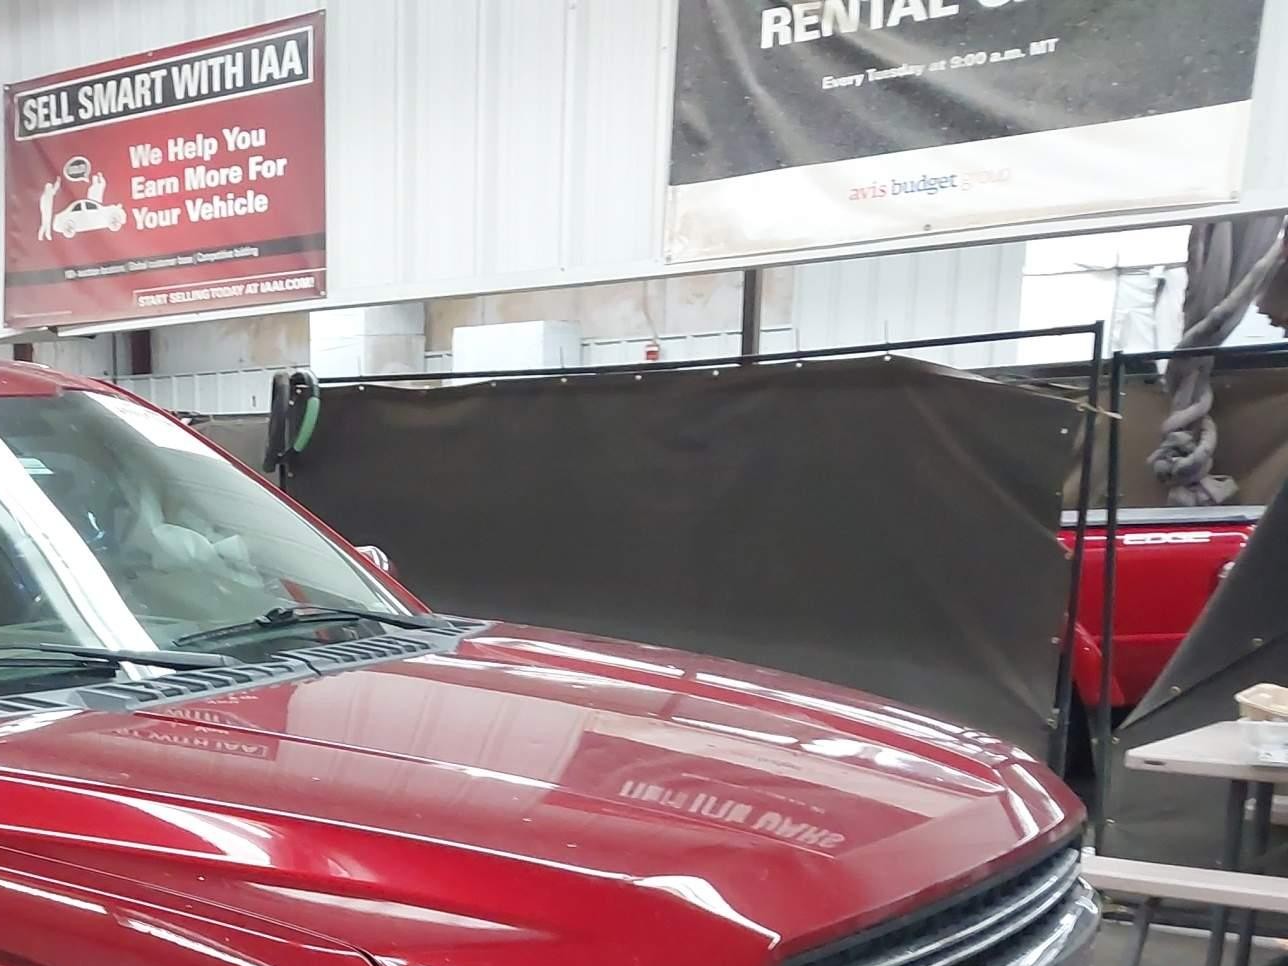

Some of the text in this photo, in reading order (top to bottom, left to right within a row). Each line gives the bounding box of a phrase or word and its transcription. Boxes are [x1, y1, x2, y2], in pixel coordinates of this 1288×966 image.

[760, 0, 961, 49] RENTAL
[821, 38, 1060, 89] Every Tuesday at 9:00 a.m. MT
[22, 40, 304, 131] SELL SMART WITH IAA
[128, 126, 266, 169] We Help You
[130, 156, 288, 200] Earn More For
[848, 181, 888, 200] avis
[891, 174, 959, 195] budget
[132, 189, 269, 230] Your Vehicle
[138, 292, 169, 307] START
[169, 288, 211, 304] SELLING
[211, 285, 245, 299] TODAY
[245, 282, 260, 294] AT
